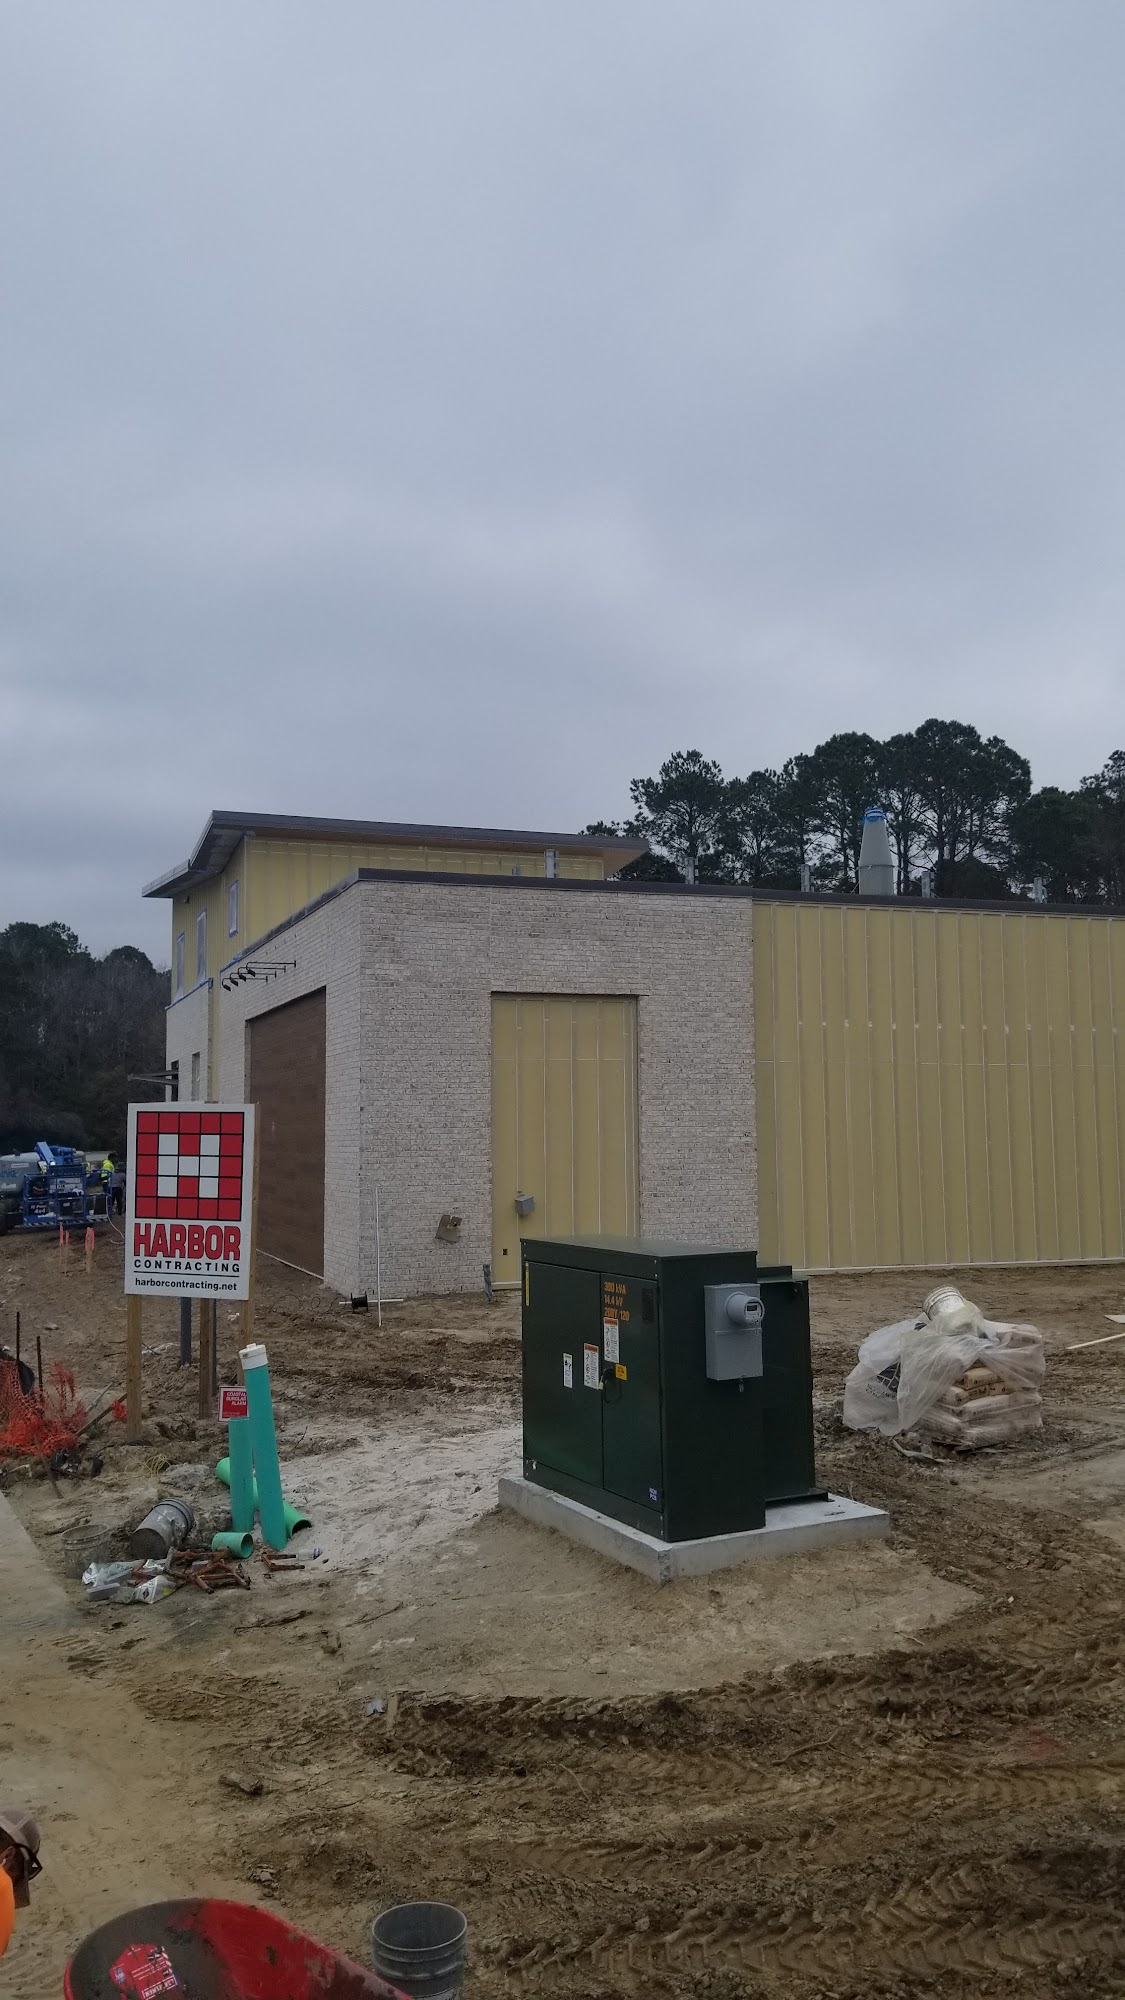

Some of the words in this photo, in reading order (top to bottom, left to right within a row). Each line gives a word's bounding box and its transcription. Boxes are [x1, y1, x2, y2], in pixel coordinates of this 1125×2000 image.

[133, 1223, 241, 1261] HARBOR
[134, 1259, 240, 1273] CONTRACTING
[135, 1278, 237, 1292] harborcontracting.net
